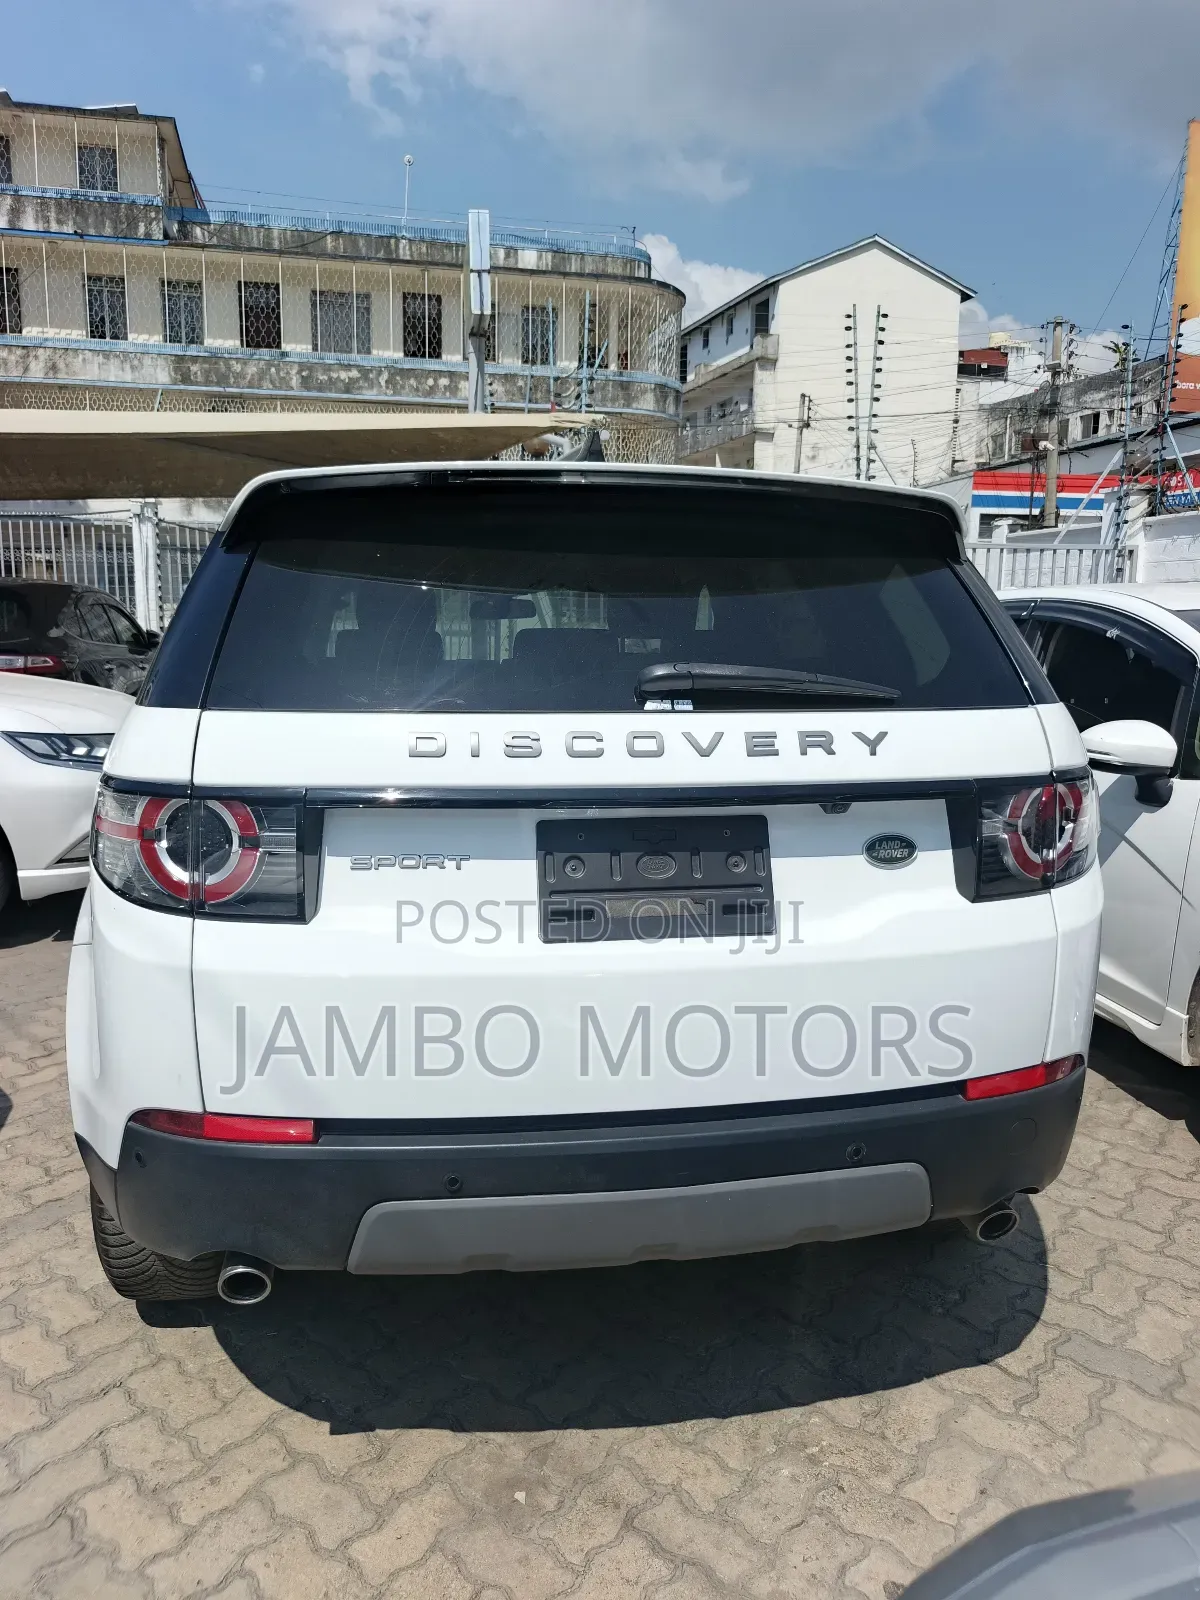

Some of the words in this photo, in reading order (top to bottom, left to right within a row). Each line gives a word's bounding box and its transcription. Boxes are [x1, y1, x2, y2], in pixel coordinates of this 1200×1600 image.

[408, 730, 889, 758] DISCOVERY
[875, 840, 901, 850] LAND
[878, 848, 909, 858] ROVER
[350, 853, 471, 871] SPORT
